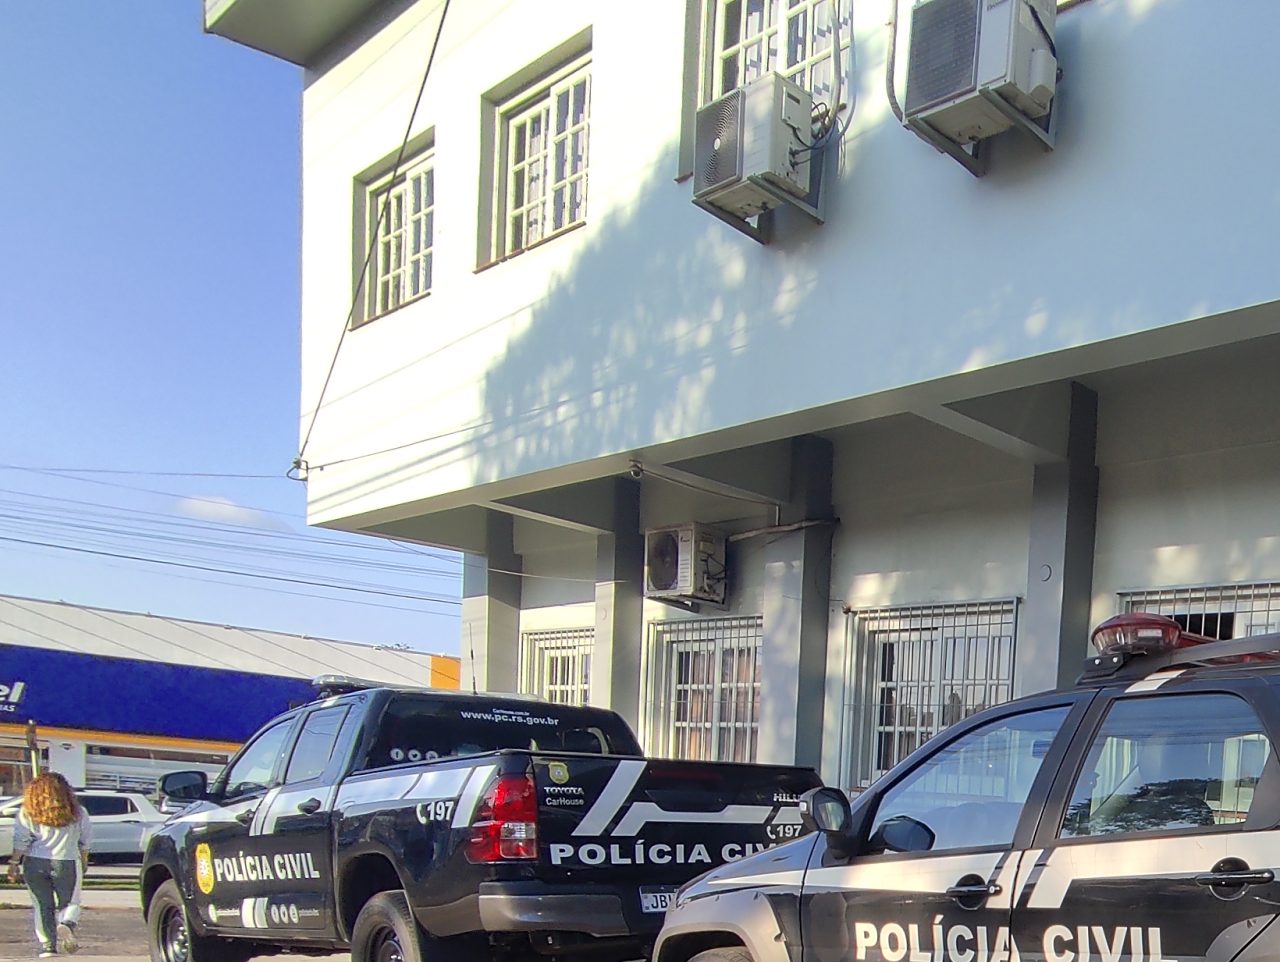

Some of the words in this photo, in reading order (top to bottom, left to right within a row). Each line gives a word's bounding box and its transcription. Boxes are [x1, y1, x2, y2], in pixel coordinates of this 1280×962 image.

[460, 711, 559, 725] www.pc.rs.gov.br
[543, 787, 585, 795] TOYOTA
[773, 793, 802, 802] HILU
[545, 797, 585, 806] CarHouse
[427, 801, 455, 821] 197
[776, 825, 802, 838] 197
[550, 839, 712, 865] POLÍCIA
[213, 851, 275, 882] POLÍCIA
[273, 852, 321, 879] CIVIL
